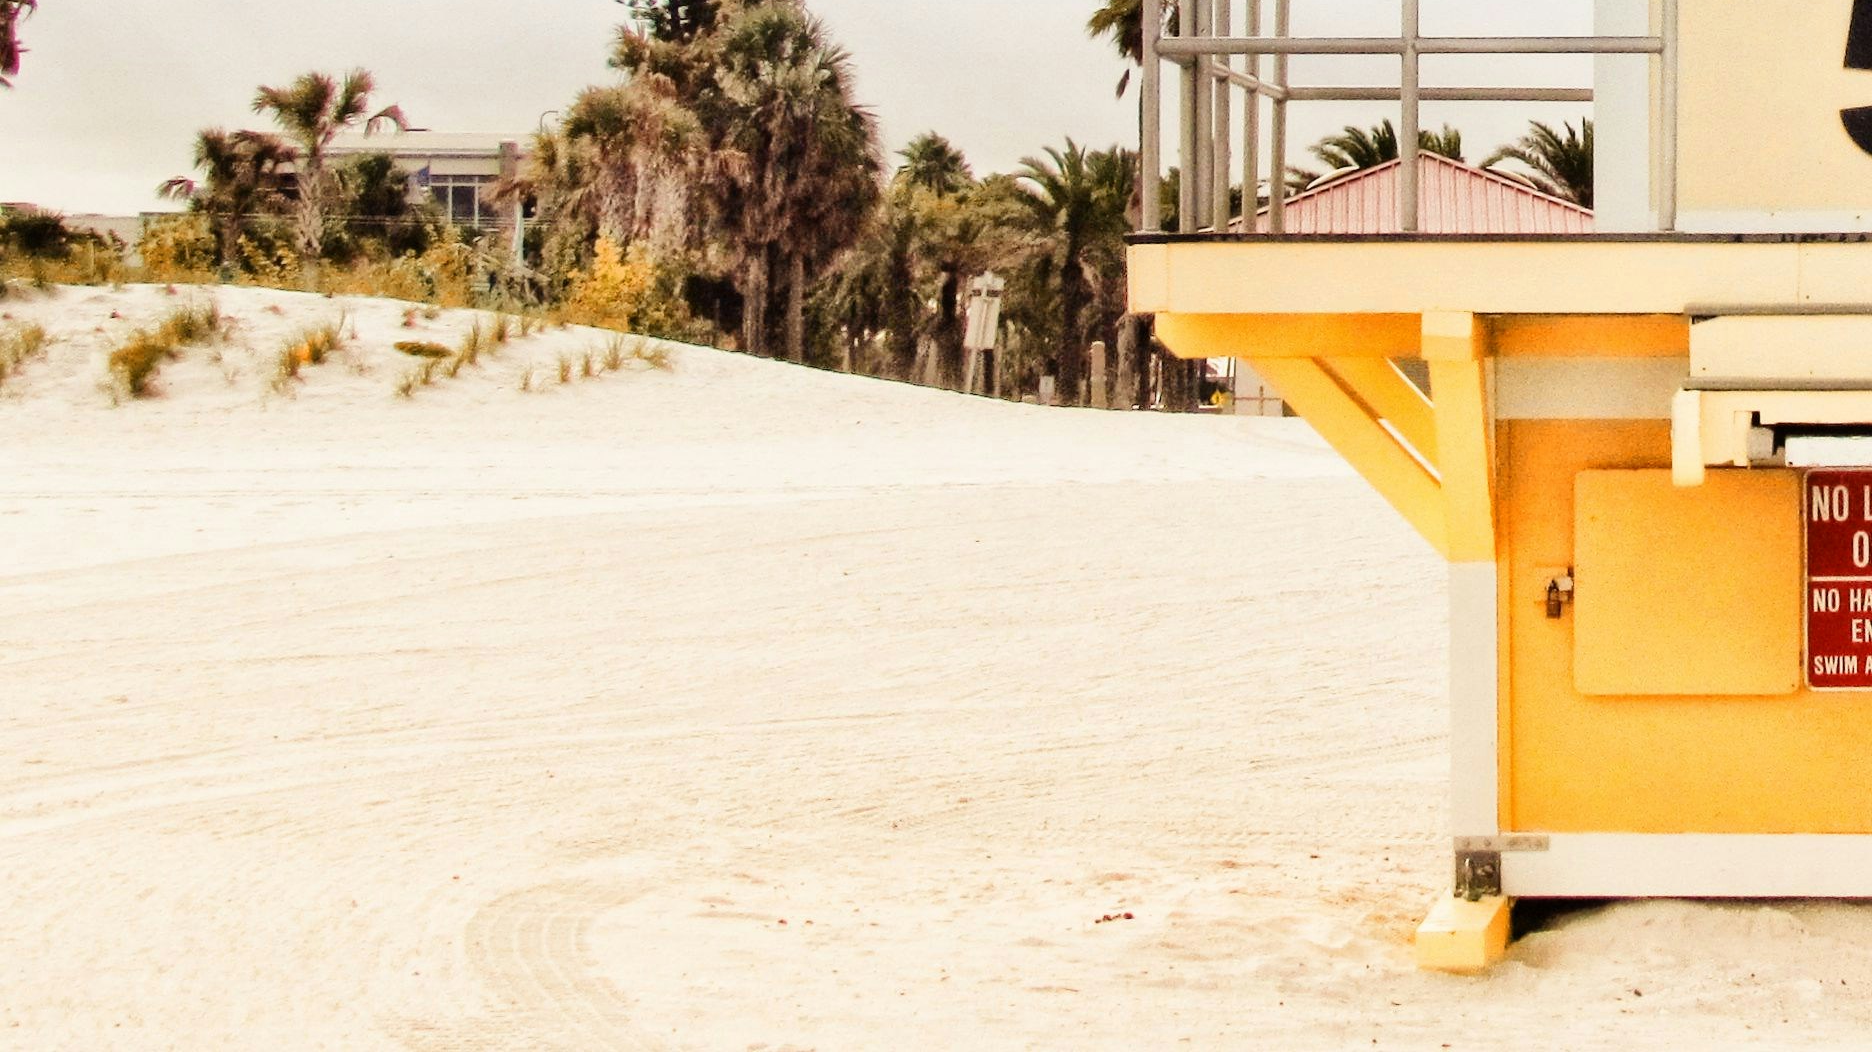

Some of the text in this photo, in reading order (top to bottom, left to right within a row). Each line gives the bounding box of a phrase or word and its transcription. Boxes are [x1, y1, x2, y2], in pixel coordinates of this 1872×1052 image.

[1812, 485, 1850, 521] NO
[1813, 589, 1839, 612] NO
[1814, 656, 1857, 675] SWIM
